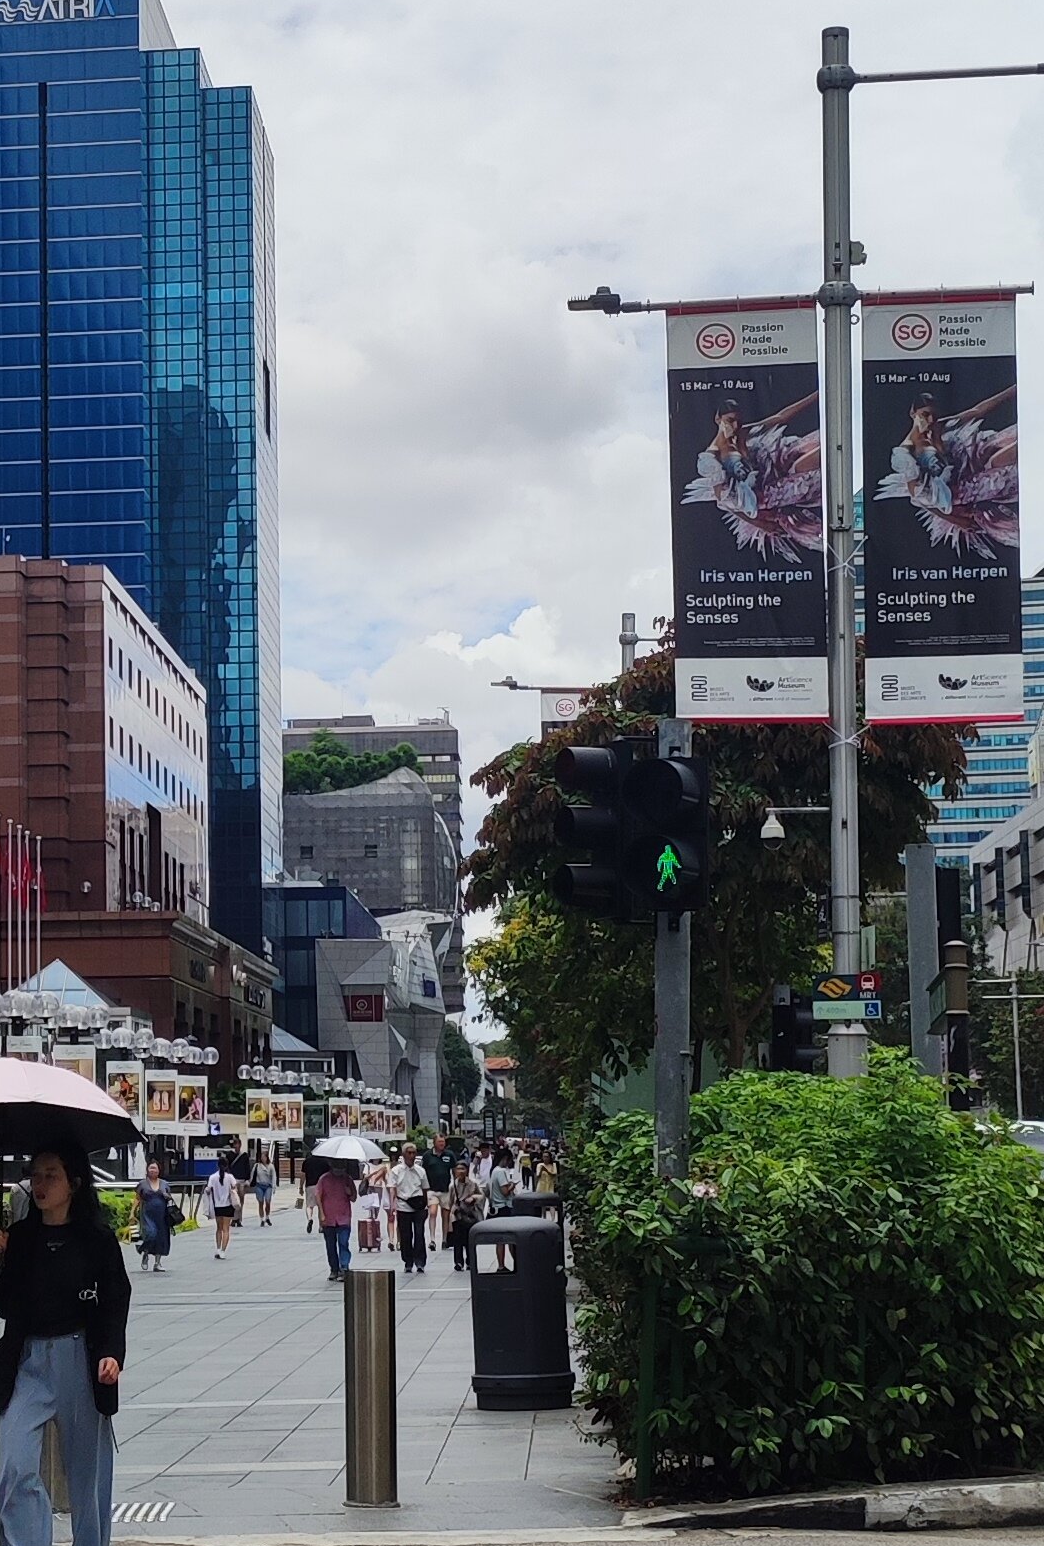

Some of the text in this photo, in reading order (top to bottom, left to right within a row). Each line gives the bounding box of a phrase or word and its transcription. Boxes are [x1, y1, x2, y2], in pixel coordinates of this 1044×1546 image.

[939, 314, 982, 323] Passion
[741, 323, 784, 333] Passion
[898, 324, 927, 340] SG
[939, 326, 970, 335] Made
[702, 334, 730, 349] SG
[742, 335, 772, 344] Made
[939, 338, 986, 347] Possible
[742, 346, 788, 356] Possible
[875, 374, 886, 383] 15
[888, 374, 907, 383] Mar
[918, 373, 929, 382] 10
[931, 372, 950, 383] Aug
[680, 382, 691, 391] 15
[693, 381, 712, 391] Mar
[722, 380, 734, 389] 10
[736, 379, 754, 390] Aug
[700, 569, 813, 584] Iris van Herpen
[892, 566, 1008, 580] Iris van Herpen
[685, 593, 782, 609] Sculpting the
[877, 591, 976, 607] Sculpting the
[686, 611, 739, 624] Senses
[877, 610, 931, 622] Senses
[558, 703, 572, 711] SG
